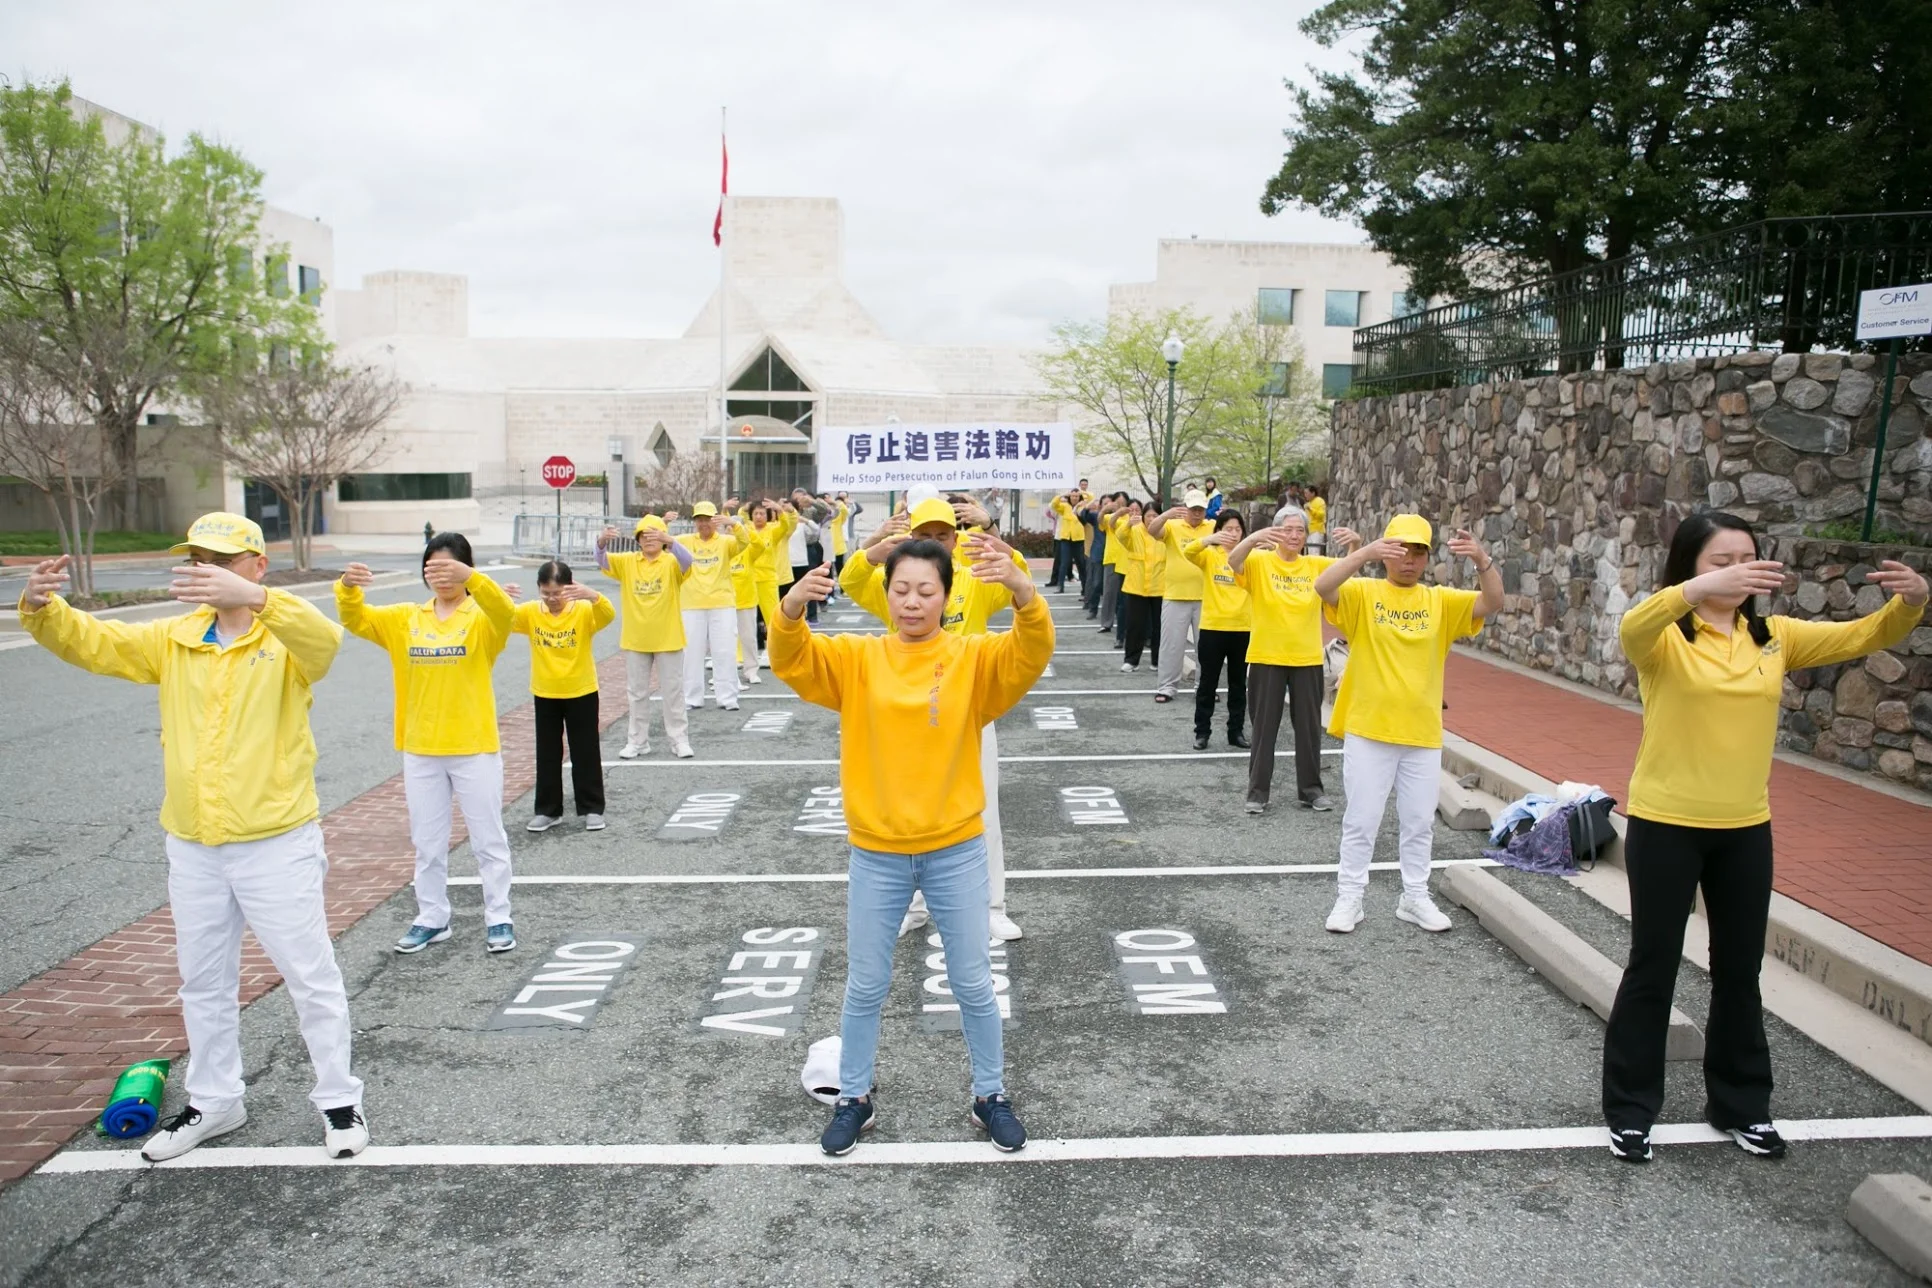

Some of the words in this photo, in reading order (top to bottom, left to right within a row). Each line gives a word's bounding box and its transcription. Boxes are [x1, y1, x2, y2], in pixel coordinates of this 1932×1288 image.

[1879, 291, 1919, 305] OFM
[1861, 321, 1898, 329] Customer
[1900, 318, 1930, 326] Service
[847, 429, 1051, 464] 停止迫害法輪功
[544, 465, 574, 479] STOP
[832, 473, 855, 484] Help
[859, 473, 882, 484] Stop
[885, 471, 942, 482] Persecution
[946, 470, 957, 481] of
[960, 470, 988, 480] Falun
[991, 469, 1018, 482] Gong
[1021, 469, 1031, 479] in
[1034, 469, 1064, 480] China
[1271, 573, 1292, 583] FALUN
[1293, 575, 1312, 583] GONG
[1375, 602, 1401, 620] FAUN
[1402, 609, 1429, 620] GONG
[439, 646, 465, 656] DAFA
[664, 792, 741, 831] ONLY
[1060, 786, 1130, 824] OFM
[1114, 929, 1227, 1014] OFM
[503, 940, 636, 1024] ONLY
[700, 927, 819, 1036] SERV
